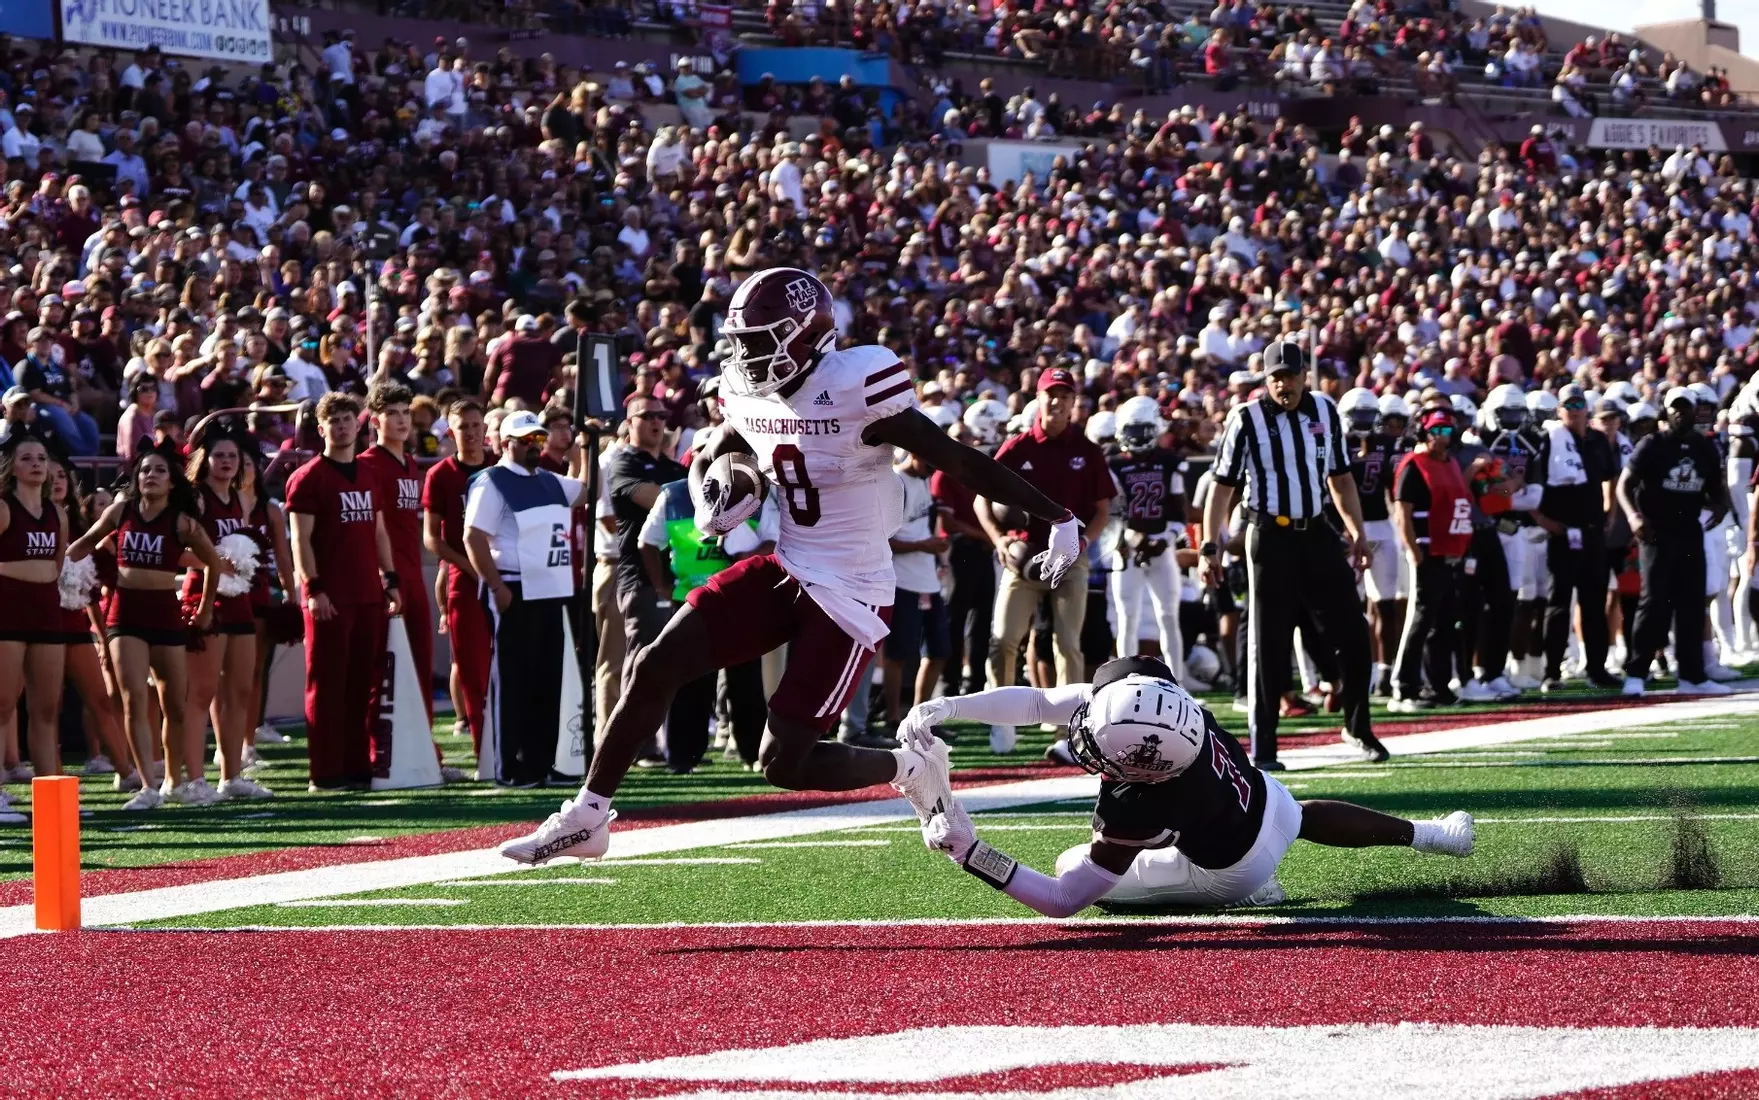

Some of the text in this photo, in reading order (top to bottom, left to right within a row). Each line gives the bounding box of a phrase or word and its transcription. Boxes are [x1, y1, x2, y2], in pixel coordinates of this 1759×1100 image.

[200, 0, 267, 32] BANK
[593, 343, 616, 411] 1
[397, 478, 419, 498] NM
[772, 444, 821, 527] 8
[1360, 461, 1382, 493] 5
[339, 490, 372, 511] NM
[1129, 481, 1165, 519] 22
[1448, 518, 1473, 534] US
[26, 531, 56, 548] NM
[122, 530, 165, 553] NM
[25, 548, 55, 556] STATE
[547, 549, 572, 567] US
